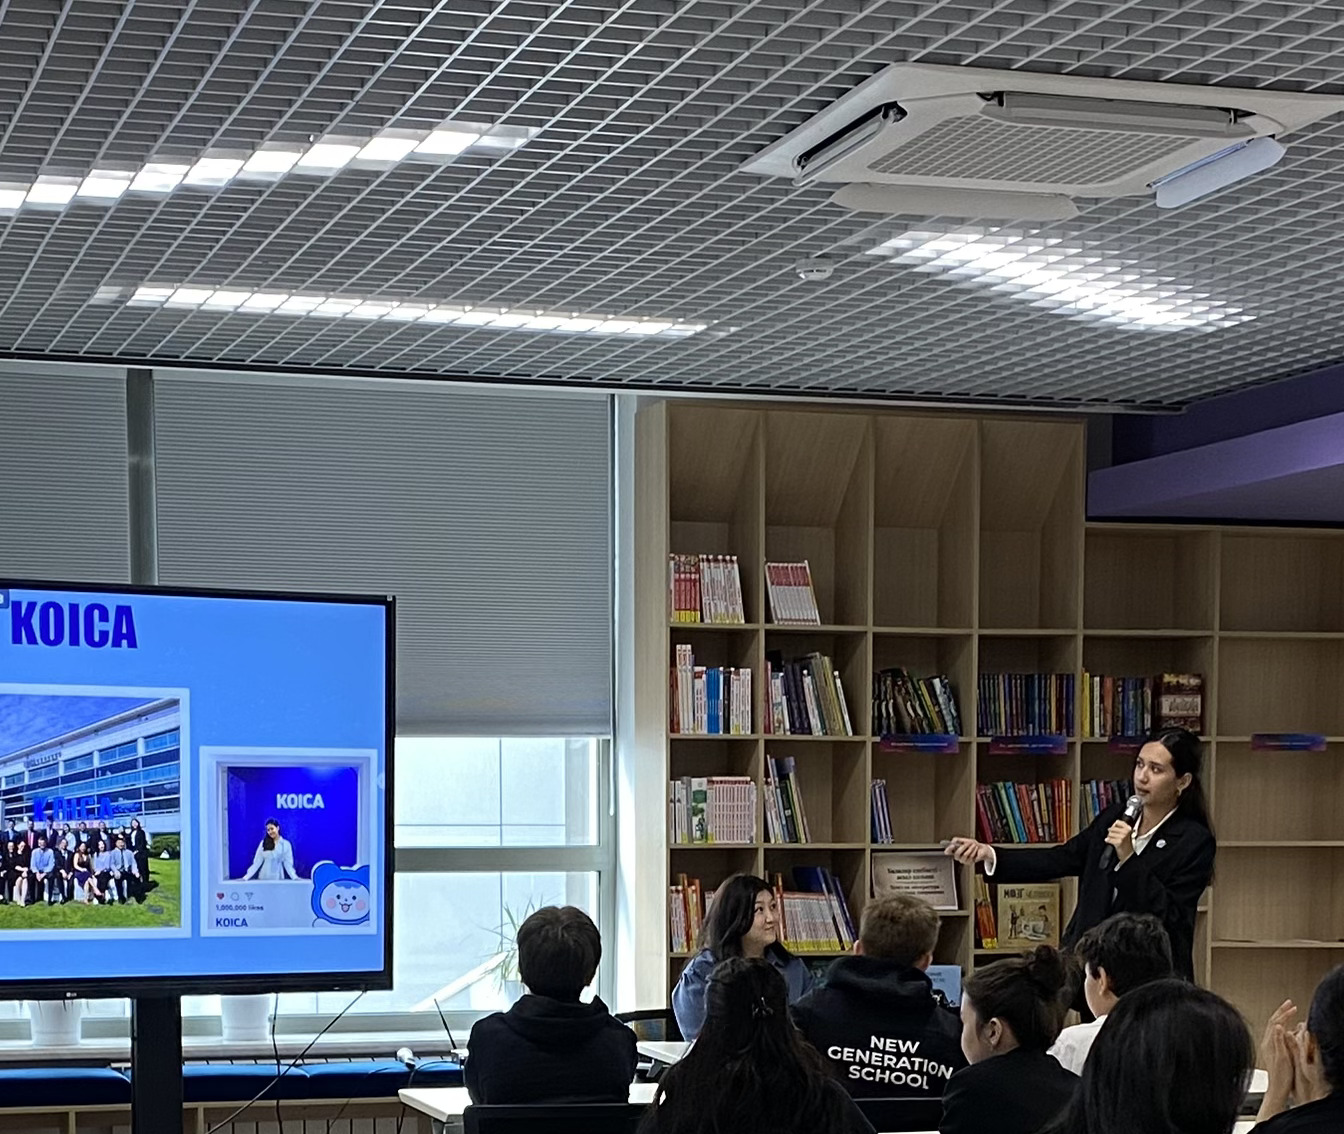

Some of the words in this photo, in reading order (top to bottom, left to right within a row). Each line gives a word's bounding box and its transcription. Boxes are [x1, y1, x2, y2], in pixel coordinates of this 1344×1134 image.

[11, 600, 138, 649] KOICA
[276, 793, 325, 809] KOICA
[215, 918, 248, 928] KOICA
[870, 1035, 920, 1054] NEW
[827, 1046, 953, 1080] GENERATION
[848, 1065, 929, 1090] SCHOOL
